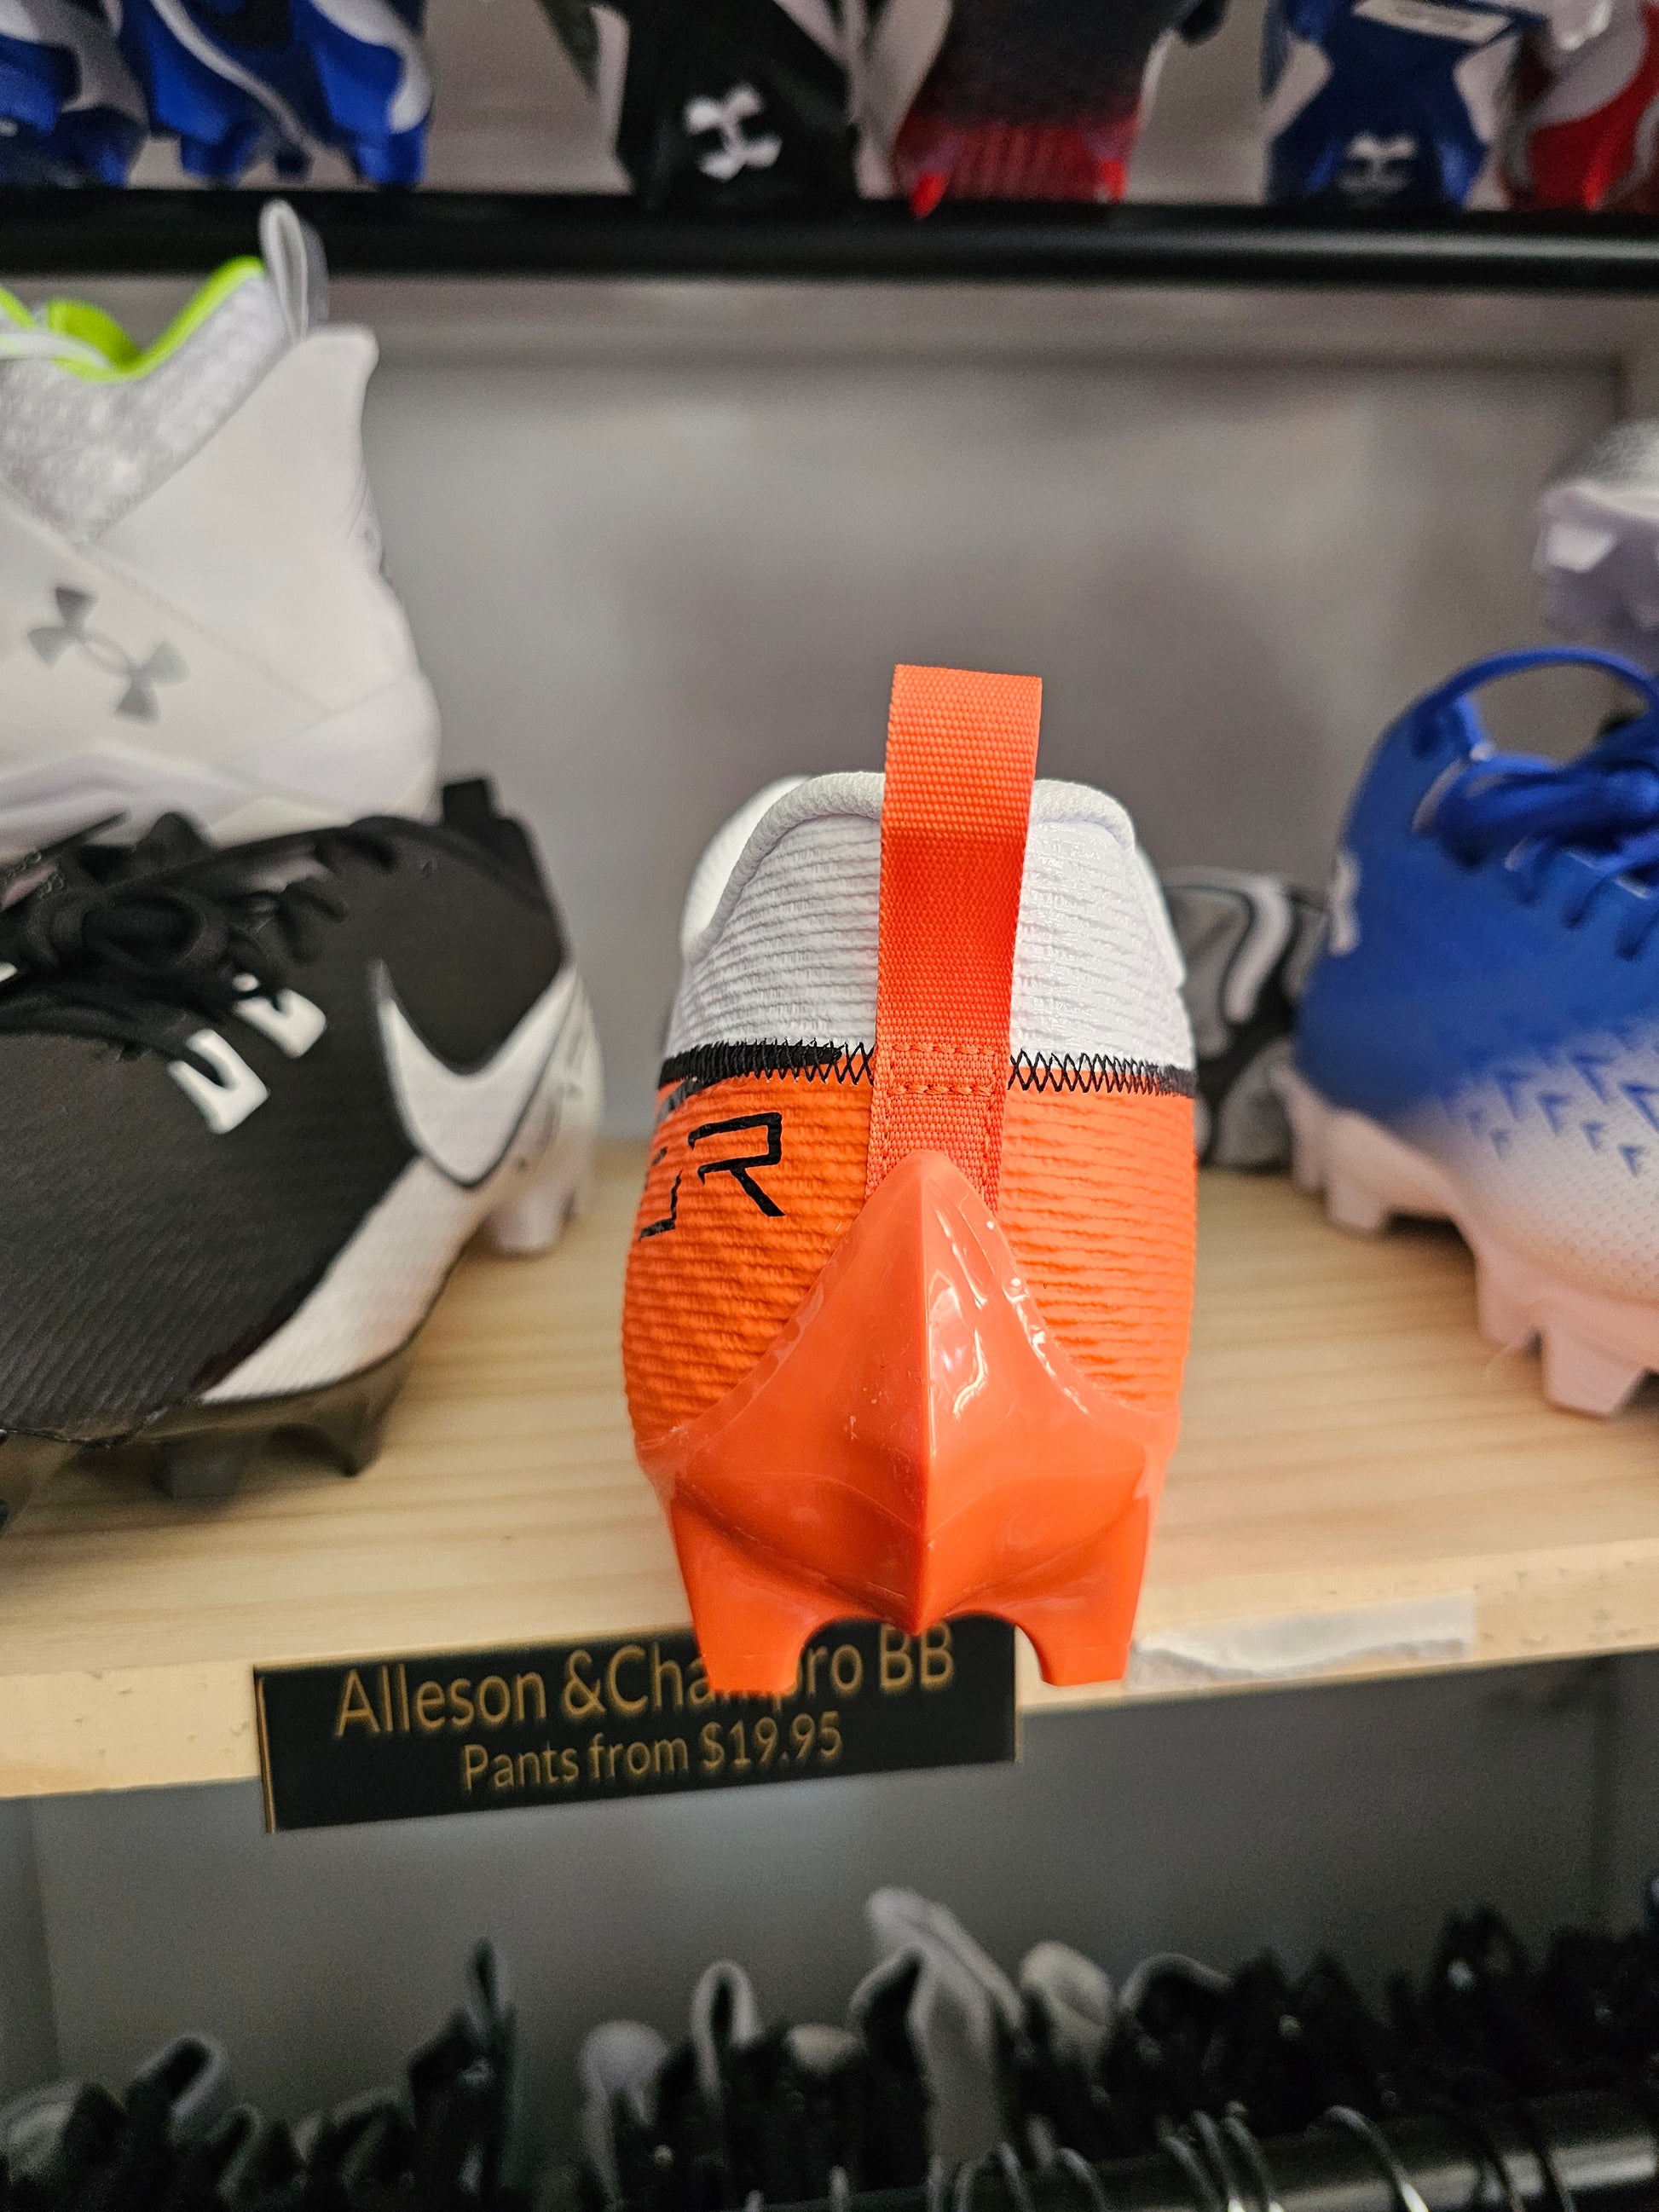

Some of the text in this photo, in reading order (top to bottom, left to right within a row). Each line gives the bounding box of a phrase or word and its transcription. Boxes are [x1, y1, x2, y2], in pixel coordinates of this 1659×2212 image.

[336, 1663, 546, 1736] Alleson
[879, 1621, 955, 1693] BB
[463, 1711, 843, 1790] Pants from $19.95
